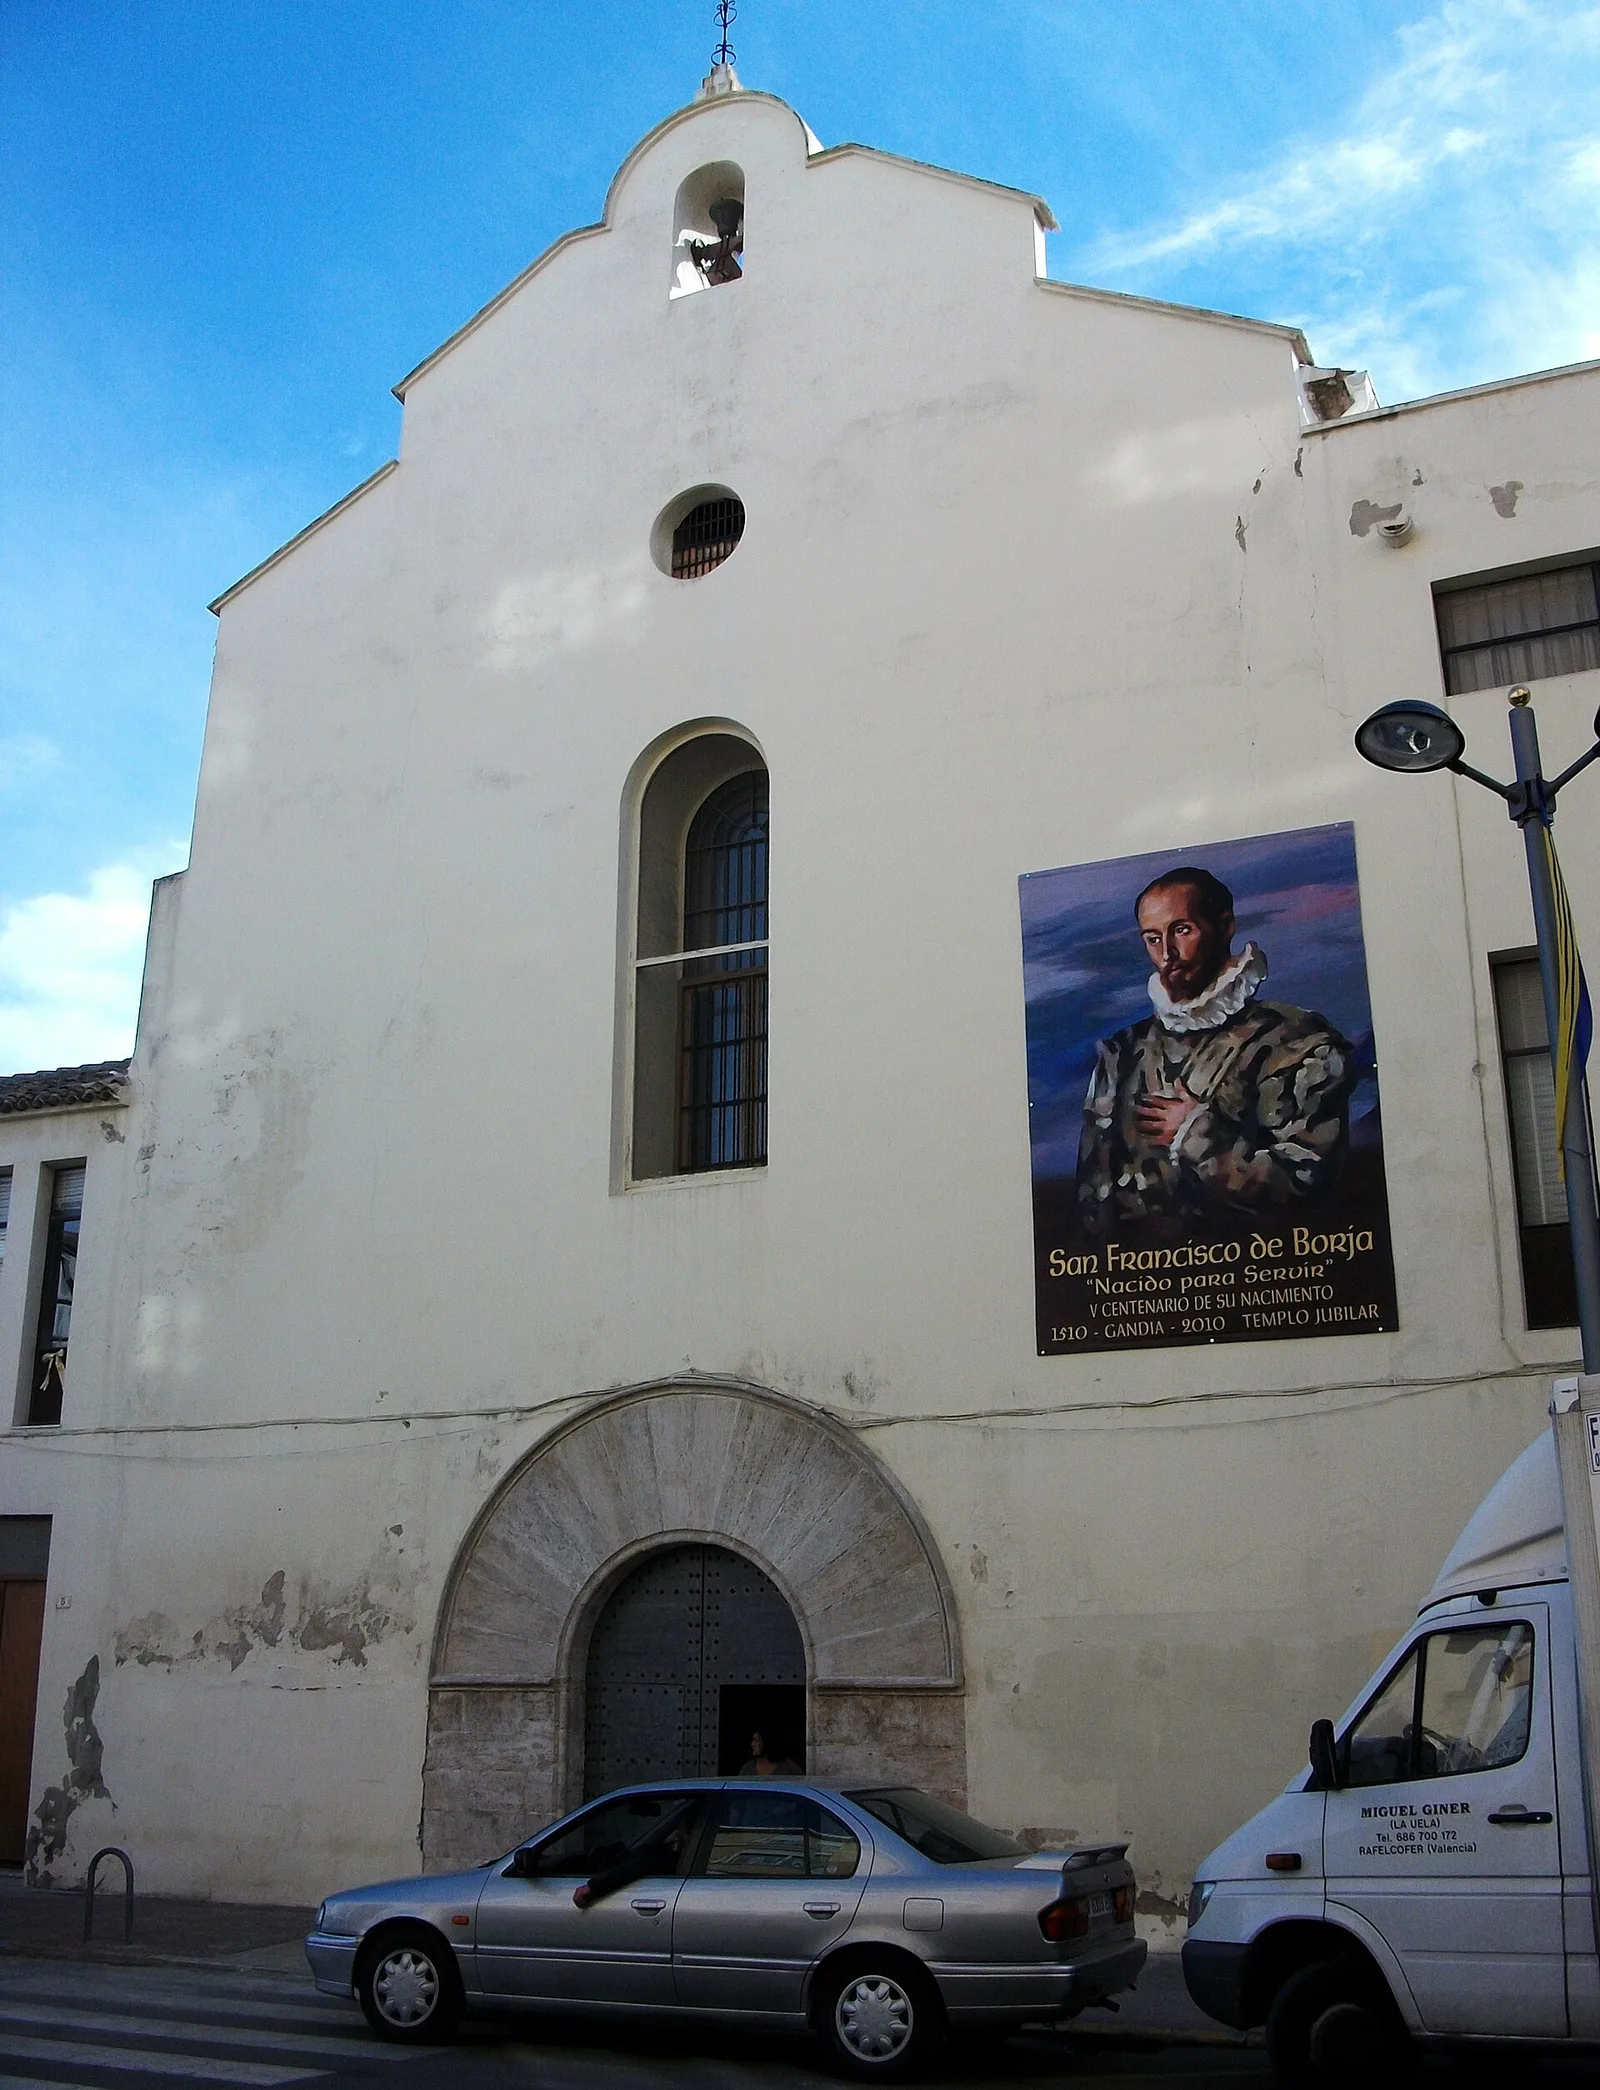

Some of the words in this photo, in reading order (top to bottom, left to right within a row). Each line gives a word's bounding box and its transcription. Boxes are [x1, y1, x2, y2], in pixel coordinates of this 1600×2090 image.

[1049, 1248, 1099, 1277] San
[1106, 1238, 1241, 1272] Francisco
[1249, 1232, 1284, 1260] de
[1292, 1225, 1374, 1261] Borja
[1180, 1272, 1235, 1294] para
[1089, 1303, 1098, 1318] V
[1101, 1296, 1190, 1318] CENTENARIO
[1194, 1294, 1212, 1312] DE
[1216, 1292, 1236, 1309] SU
[1240, 1284, 1334, 1307] NACIMIENTO
[1242, 1309, 1310, 1329] TEMPLO
[1313, 1303, 1380, 1326] JUBILAR
[1051, 1325, 1088, 1342] 1510
[1104, 1320, 1165, 1339] GANDIA
[1181, 1316, 1226, 1334] 2010
[1361, 1804, 1418, 1818] MIGUEL
[1422, 1802, 1471, 1816] GINER
[1390, 1819, 1407, 1830] (LA
[1376, 1832, 1393, 1843] Tel.
[1396, 1832, 1416, 1842] 686
[1419, 1831, 1438, 1841] 700
[1441, 1830, 1457, 1840] 172
[1359, 1844, 1424, 1856] RAFELCOFER
[1427, 1841, 1477, 1854] (Valencia)
